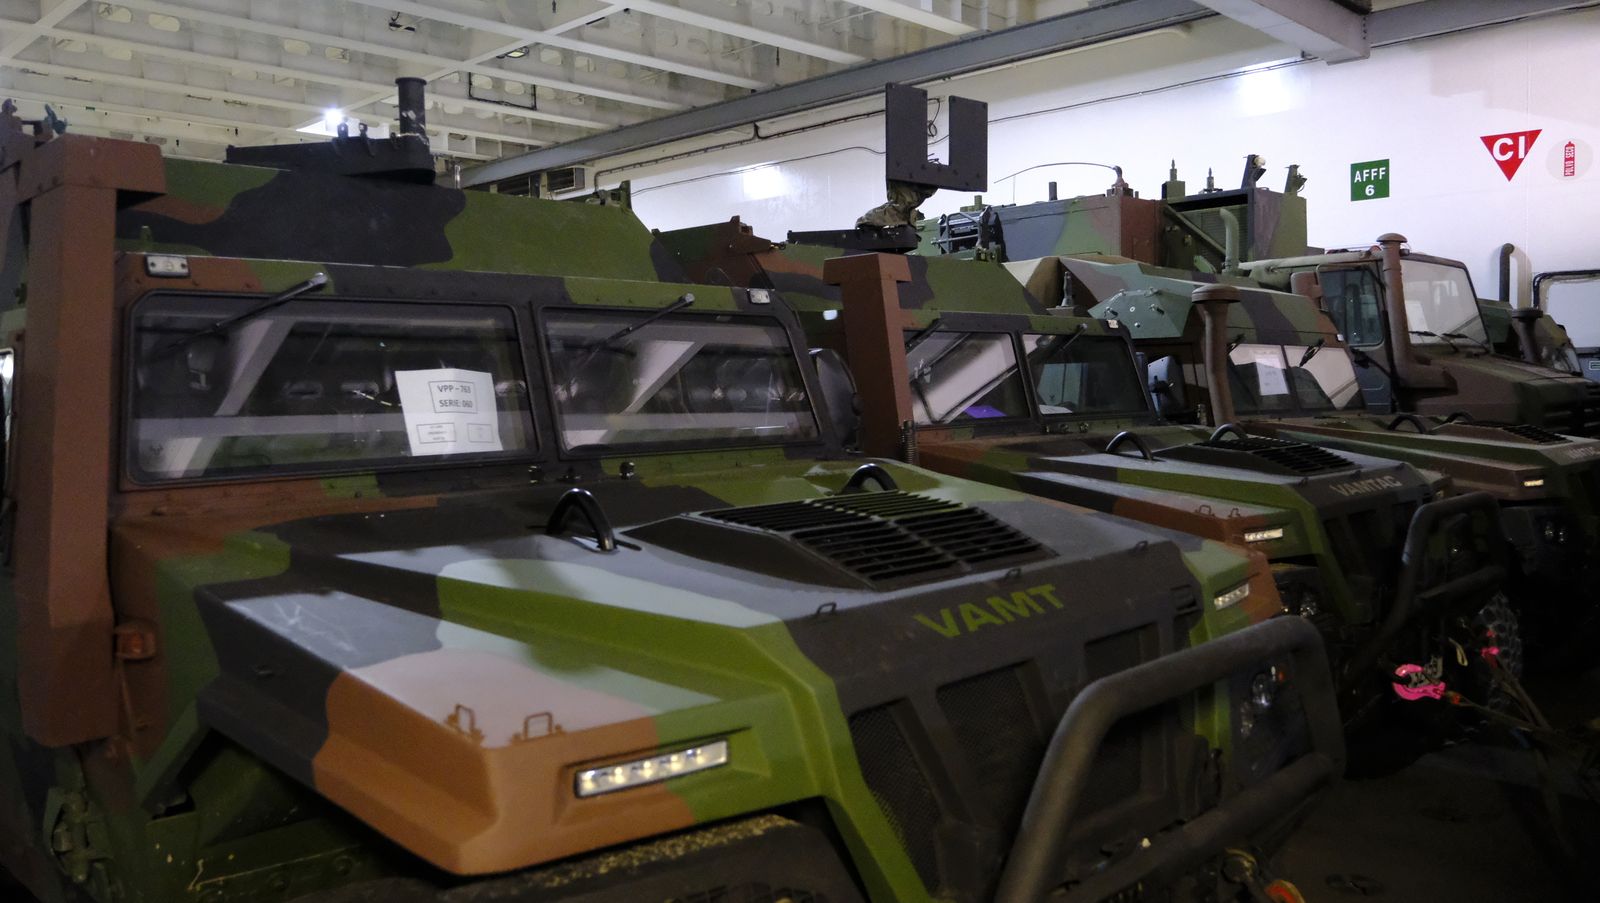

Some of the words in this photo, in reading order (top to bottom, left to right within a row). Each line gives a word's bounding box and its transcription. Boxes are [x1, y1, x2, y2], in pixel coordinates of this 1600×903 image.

[1492, 136, 1526, 161] CI
[1354, 167, 1386, 183] AFFF
[1365, 184, 1375, 196] 6
[1329, 475, 1403, 497] VAMTAC
[912, 583, 1065, 638] VAMT
